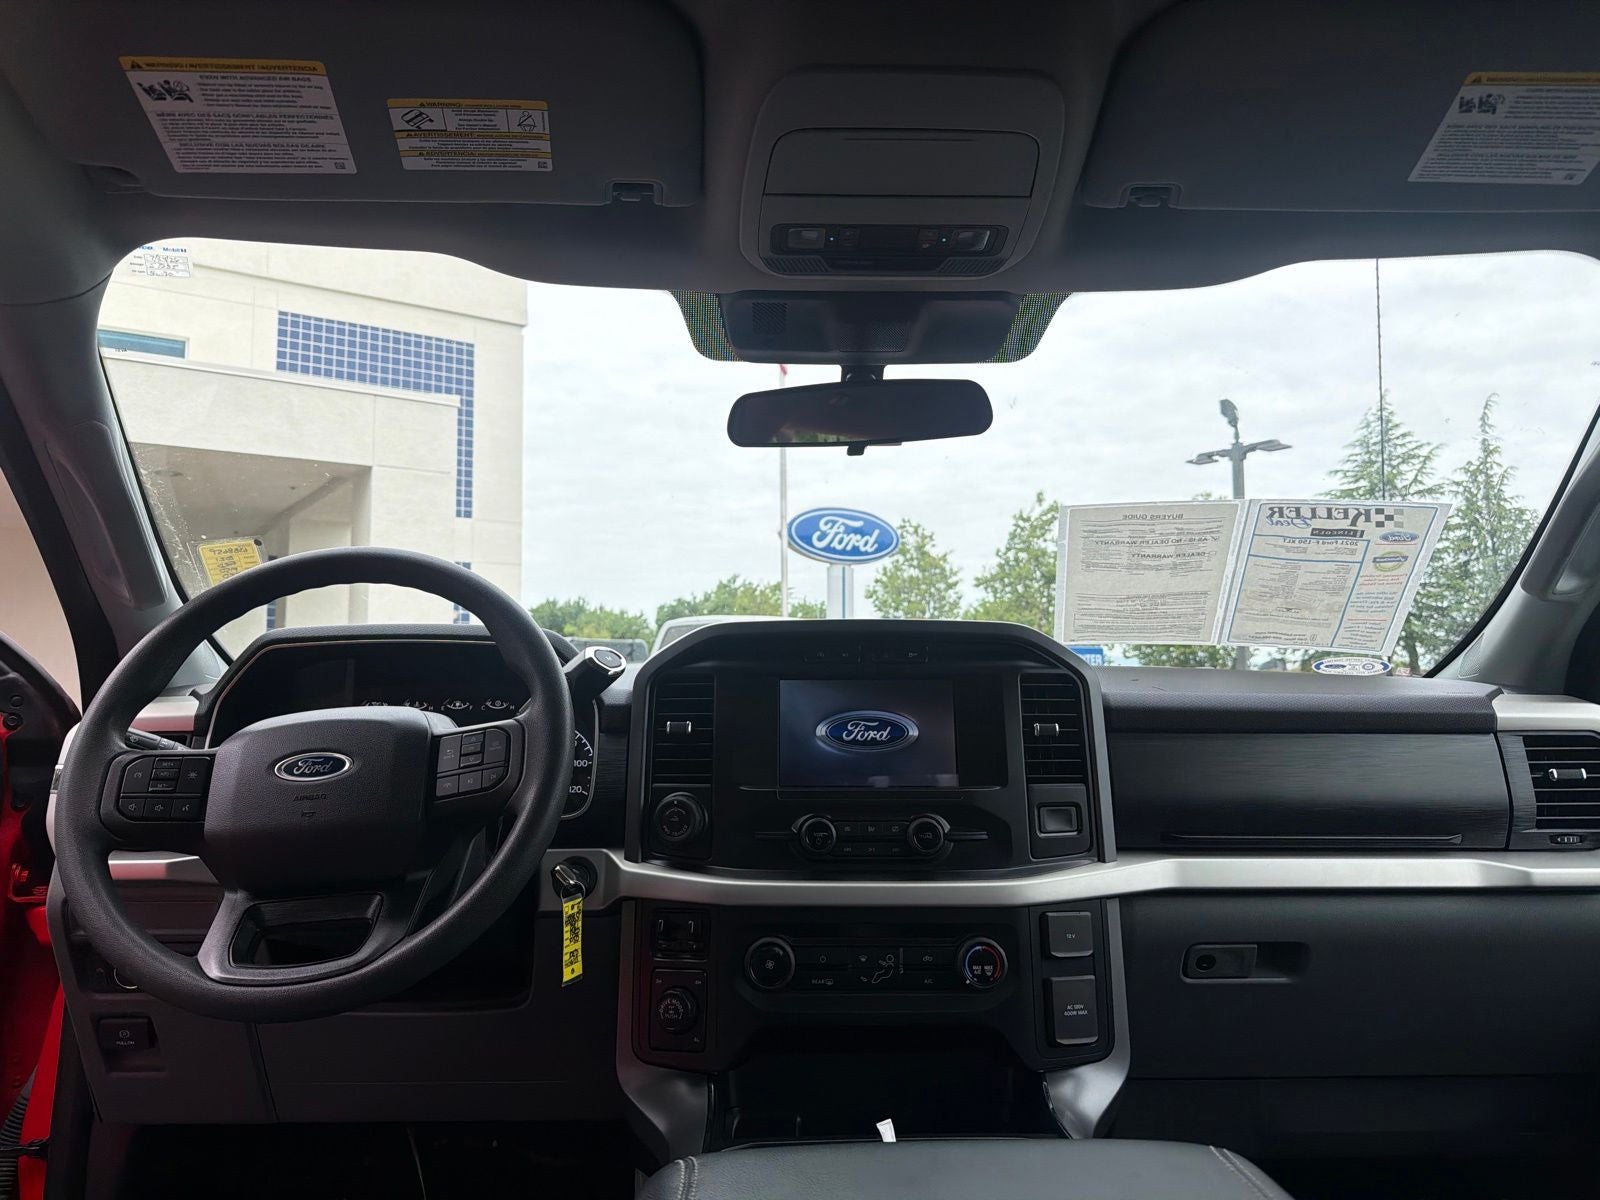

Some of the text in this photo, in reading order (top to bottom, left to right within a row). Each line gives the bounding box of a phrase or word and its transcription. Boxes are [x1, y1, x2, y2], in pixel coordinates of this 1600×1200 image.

[811, 515, 880, 553] Ford
[842, 720, 892, 742] Ford
[293, 757, 334, 775] Ford
